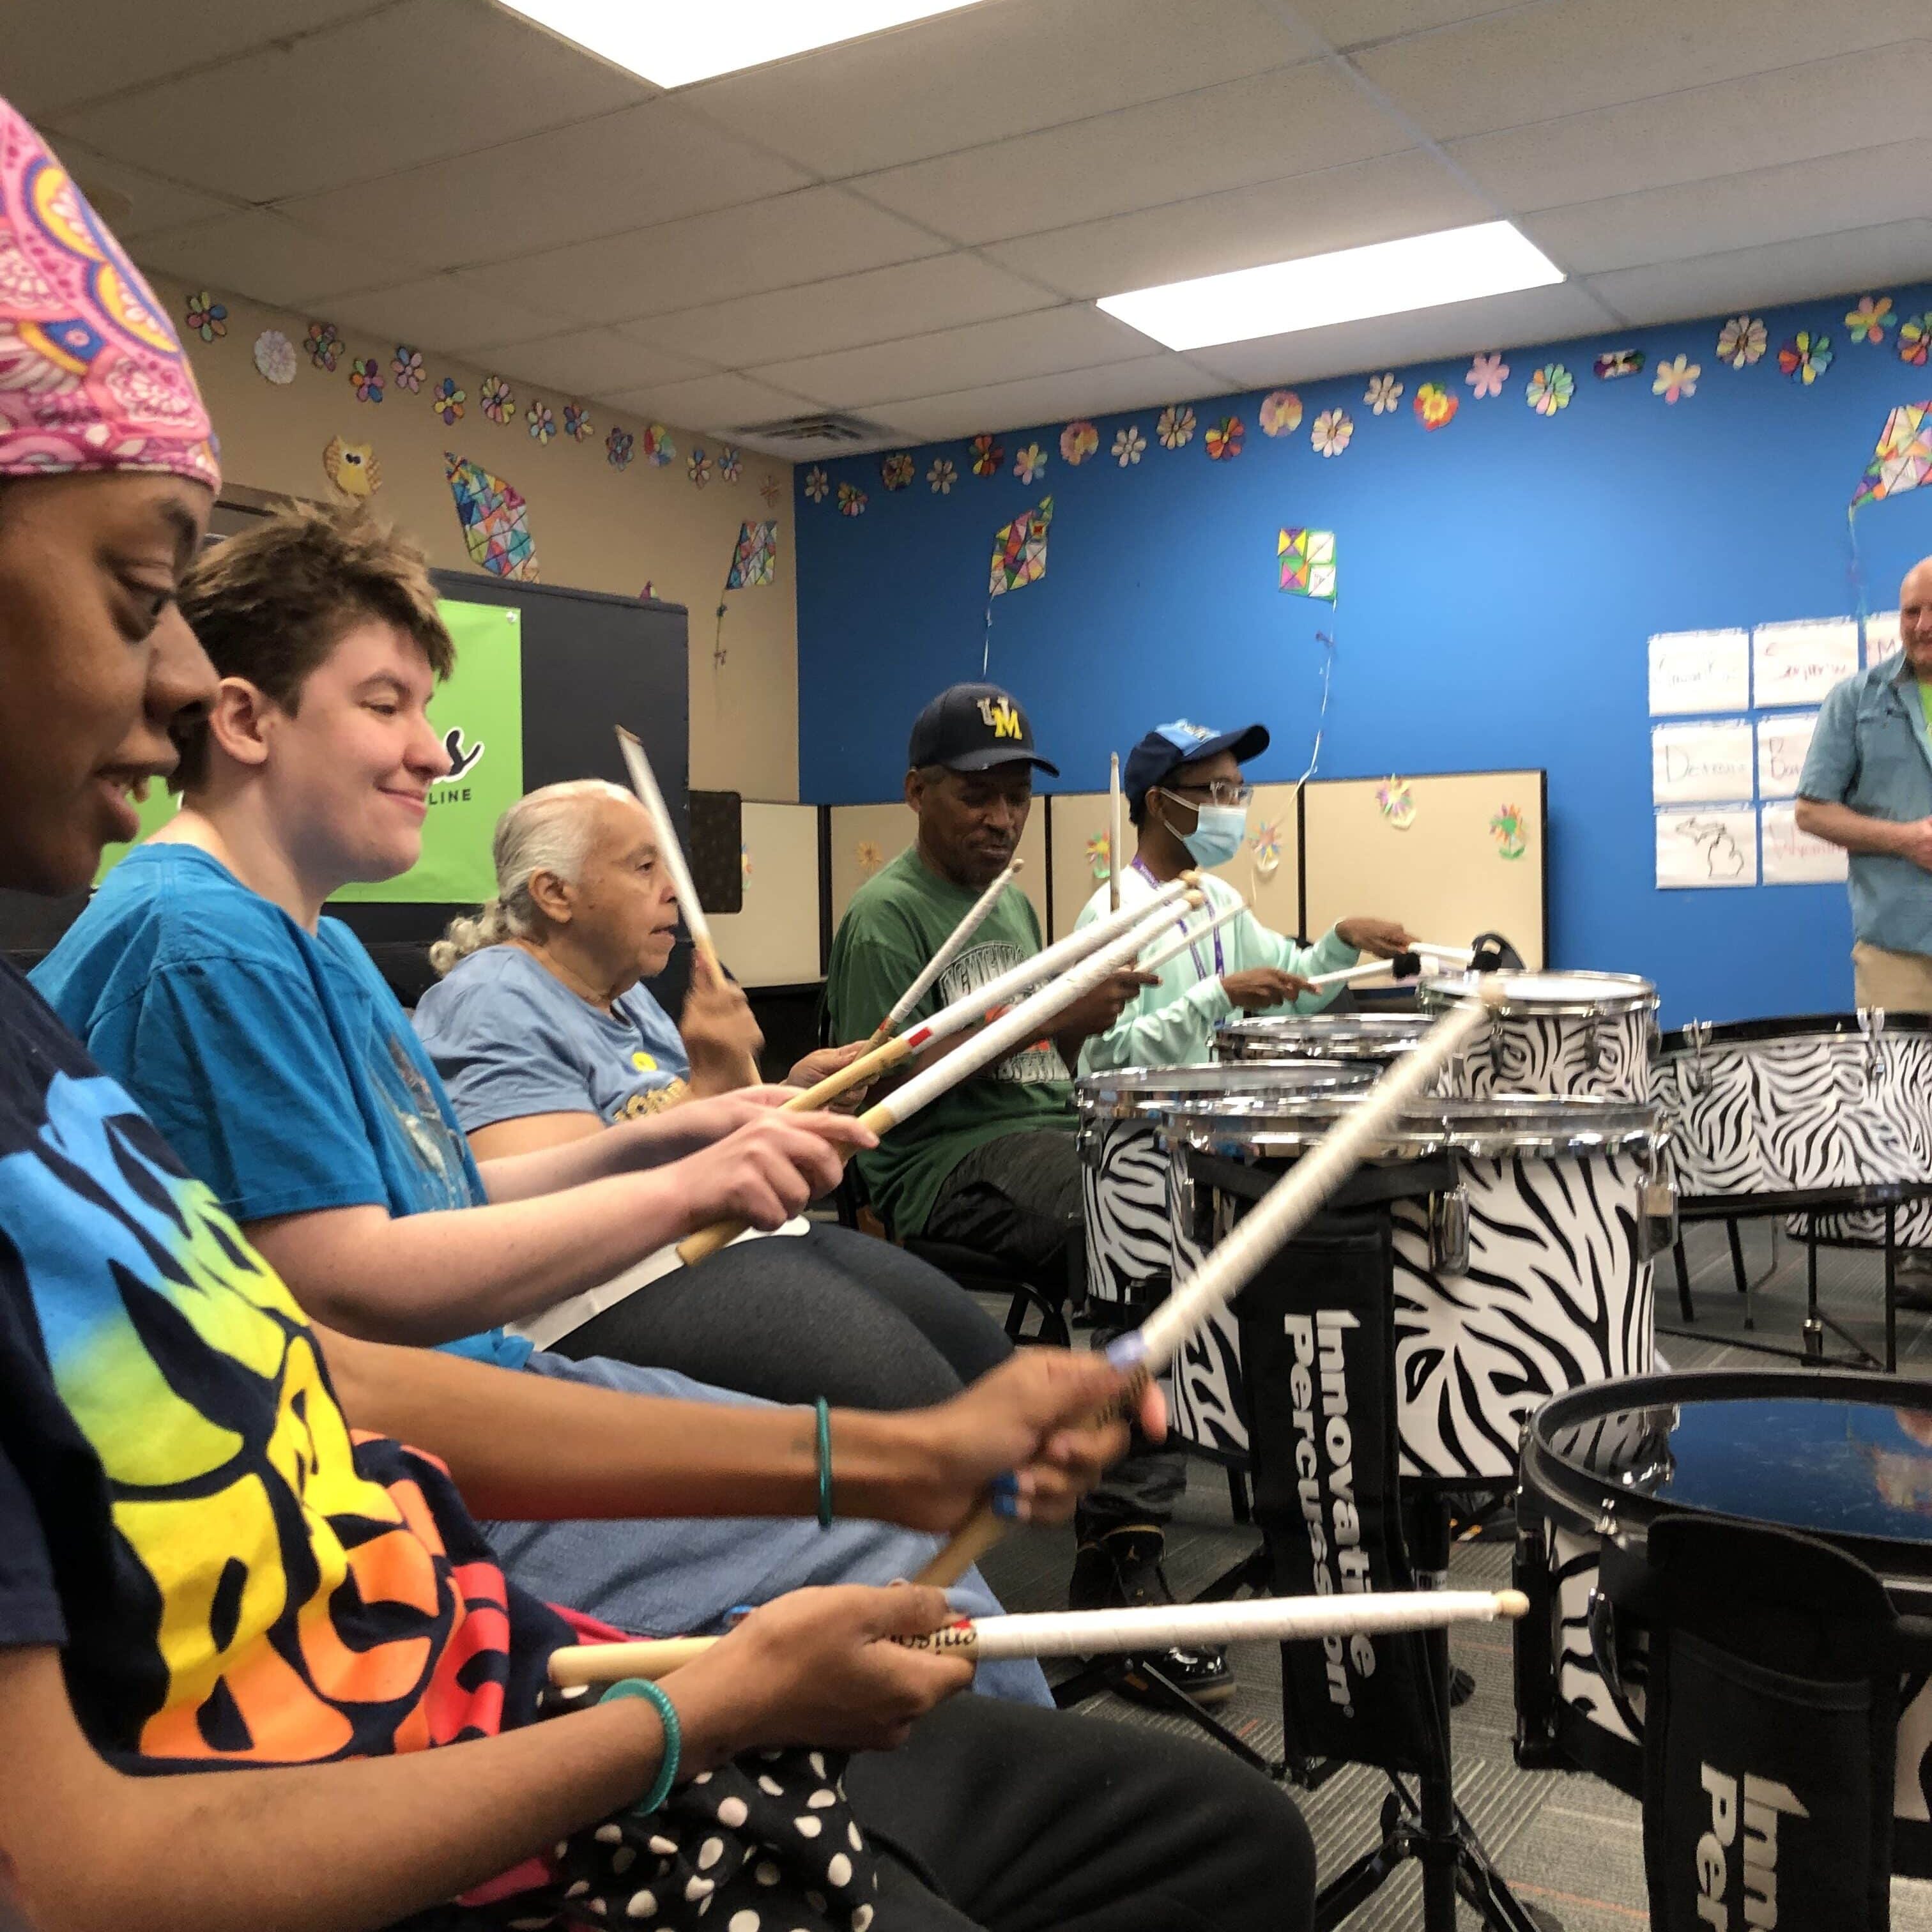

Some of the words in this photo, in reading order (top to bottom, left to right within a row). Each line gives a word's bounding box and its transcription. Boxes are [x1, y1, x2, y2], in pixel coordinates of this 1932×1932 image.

[1284, 1313, 1351, 1706] Percusson
[1315, 1309, 1376, 1679] Innovatie
[1743, 1771, 1810, 1932] Inn
